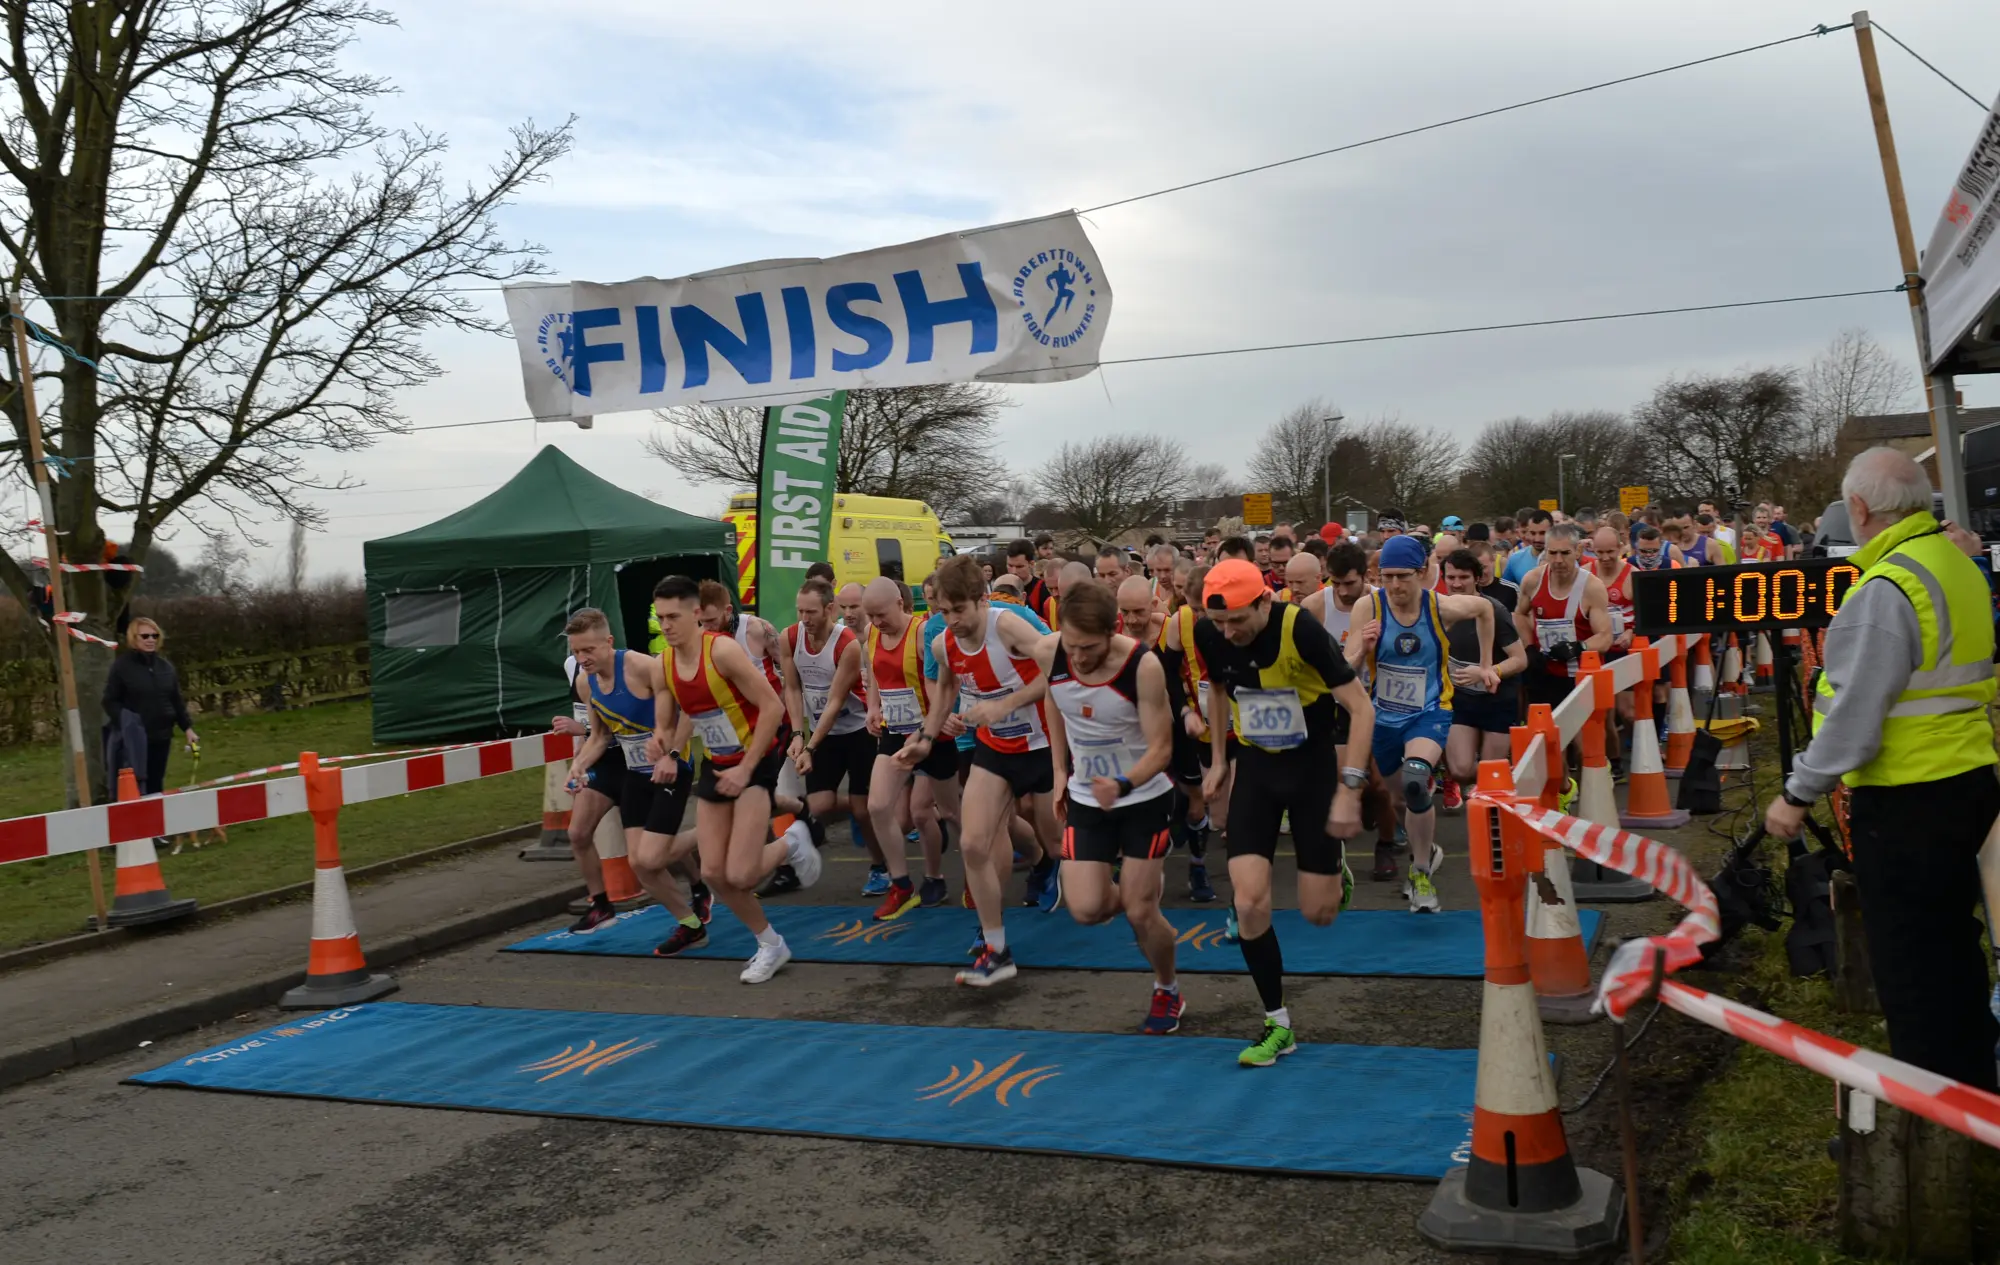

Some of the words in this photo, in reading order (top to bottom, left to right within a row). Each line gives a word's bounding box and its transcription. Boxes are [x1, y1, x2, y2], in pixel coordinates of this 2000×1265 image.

[1013, 248, 1093, 297] ROBERTTOWN
[537, 312, 575, 345] ROBERTT
[572, 262, 998, 398] FINISH
[1022, 312, 1050, 346] ROAD
[1052, 303, 1096, 348] RUNNERS
[776, 404, 831, 465] AID
[770, 470, 824, 569] FIRST
[1668, 566, 1860, 623] 11:00:0
[886, 703, 915, 723] 275
[1385, 679, 1417, 702] 122
[1247, 703, 1292, 730] 369
[1081, 752, 1123, 779] 201
